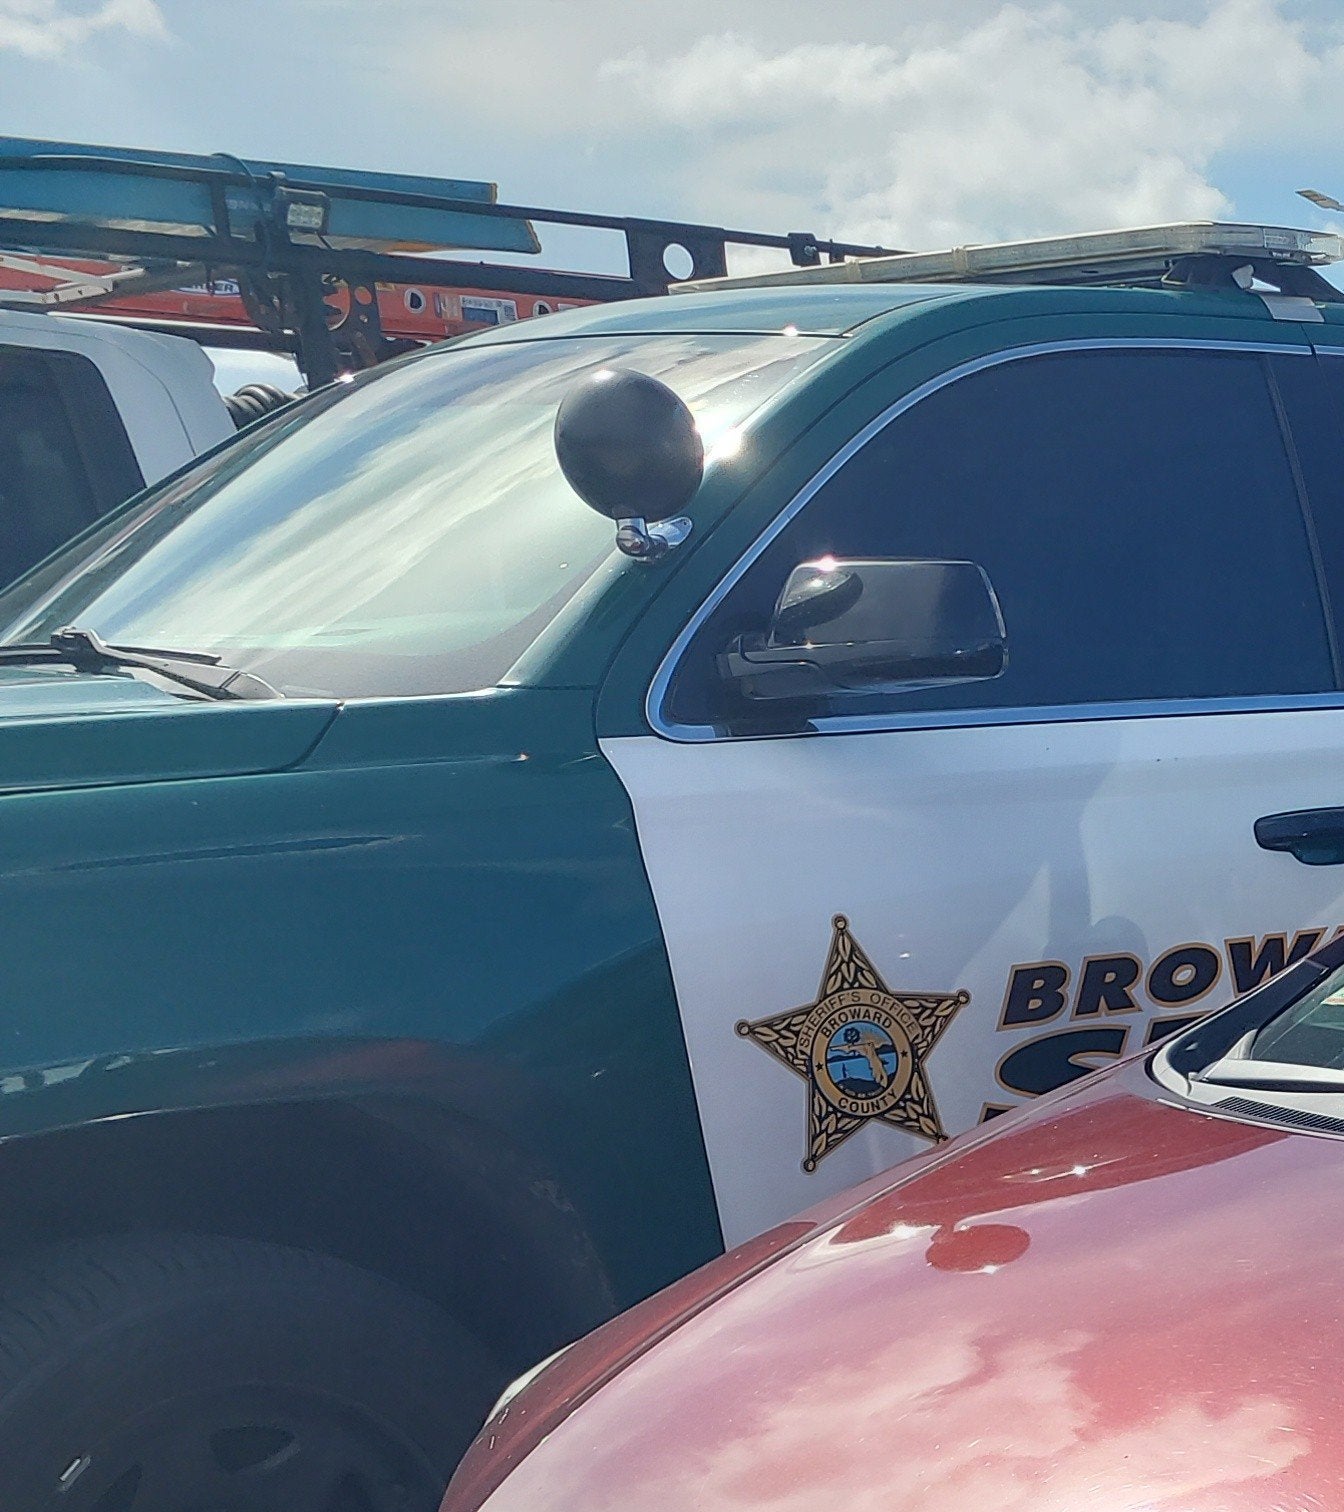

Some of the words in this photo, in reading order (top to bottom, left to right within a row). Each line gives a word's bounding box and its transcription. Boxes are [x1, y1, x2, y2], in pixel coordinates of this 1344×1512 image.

[800, 991, 861, 1048] SHERIFF'S
[869, 992, 917, 1035] OFFICE
[820, 1007, 893, 1039] BROWARD
[838, 1088, 898, 1115] COUNTY
